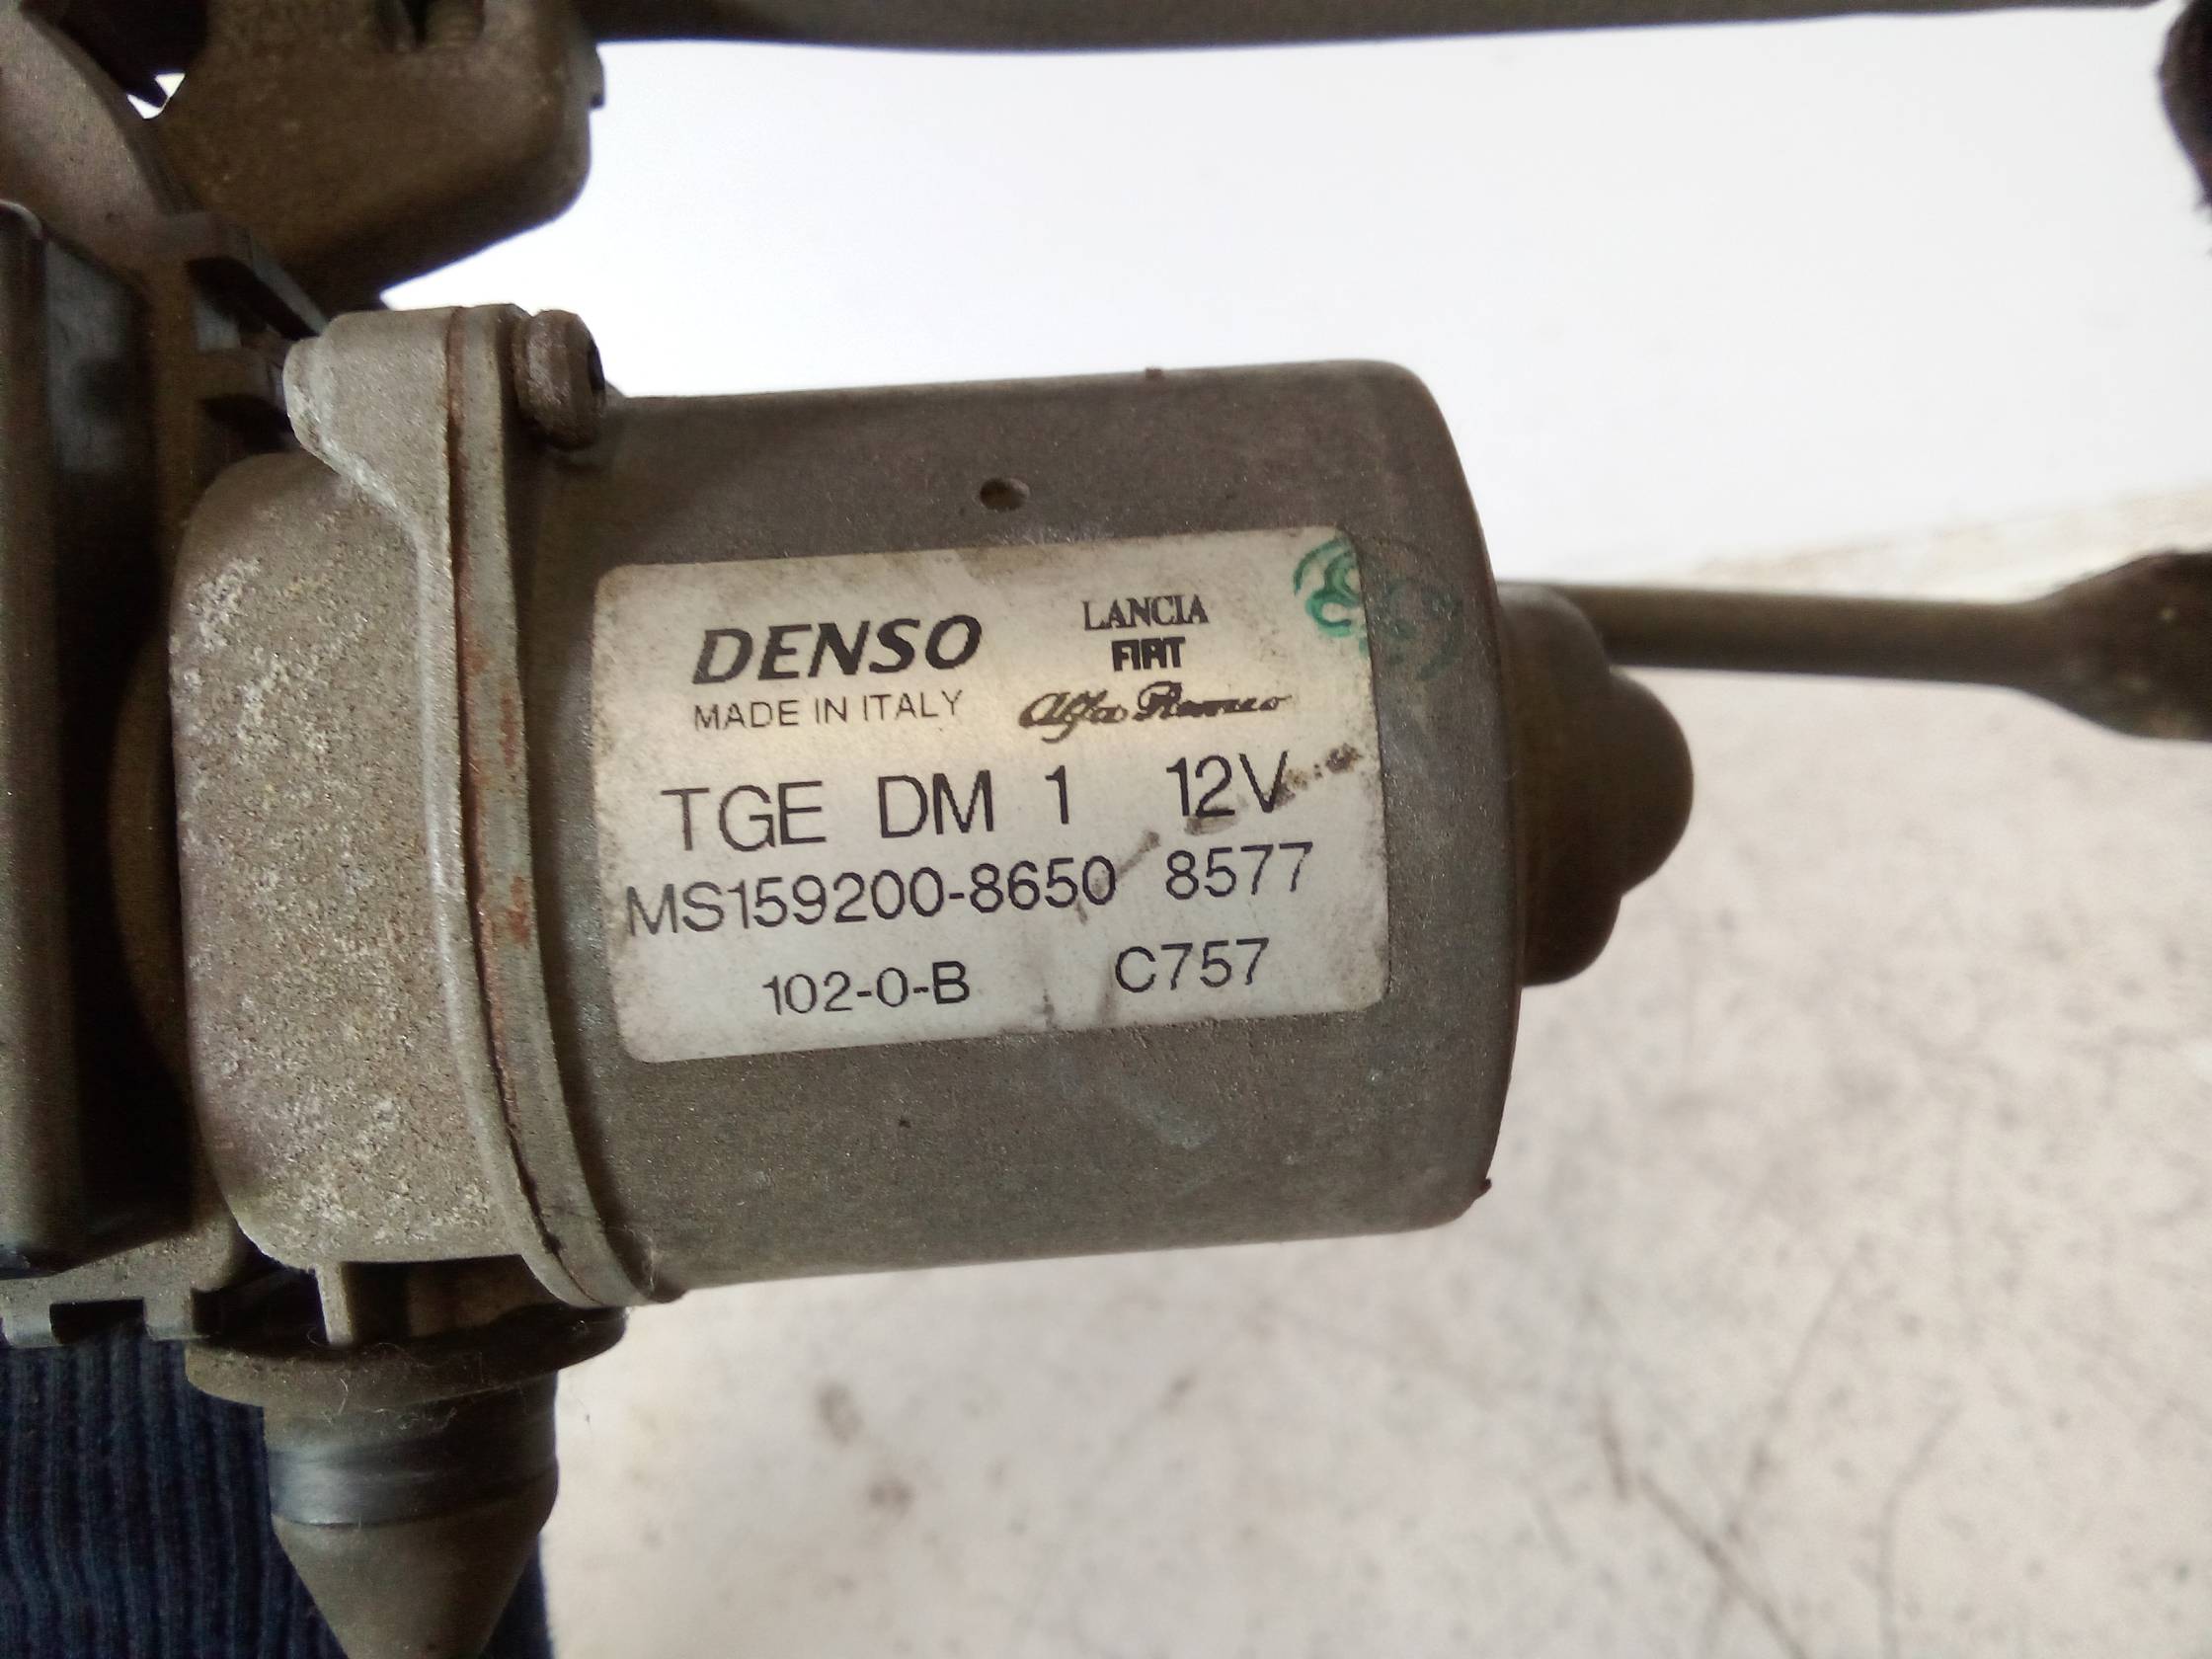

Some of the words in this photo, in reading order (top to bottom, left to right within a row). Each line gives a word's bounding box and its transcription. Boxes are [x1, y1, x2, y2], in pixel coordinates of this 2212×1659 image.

[1082, 594, 1209, 632] LANCIA
[692, 614, 982, 684] DENSO
[1111, 635, 1186, 672] FIAT
[694, 697, 800, 732] MADE
[814, 694, 848, 726] IN
[863, 688, 963, 725] ITALY
[1018, 688, 1128, 744] Alfa
[661, 771, 827, 853] TGE
[877, 763, 993, 838] DM
[1045, 764, 1070, 826] 1
[1166, 750, 1291, 819] 12V
[626, 856, 1118, 936] MS159200-8650
[1165, 840, 1314, 900] 8577
[761, 960, 971, 1016] 102-0-B
[1114, 936, 1270, 994] C757
